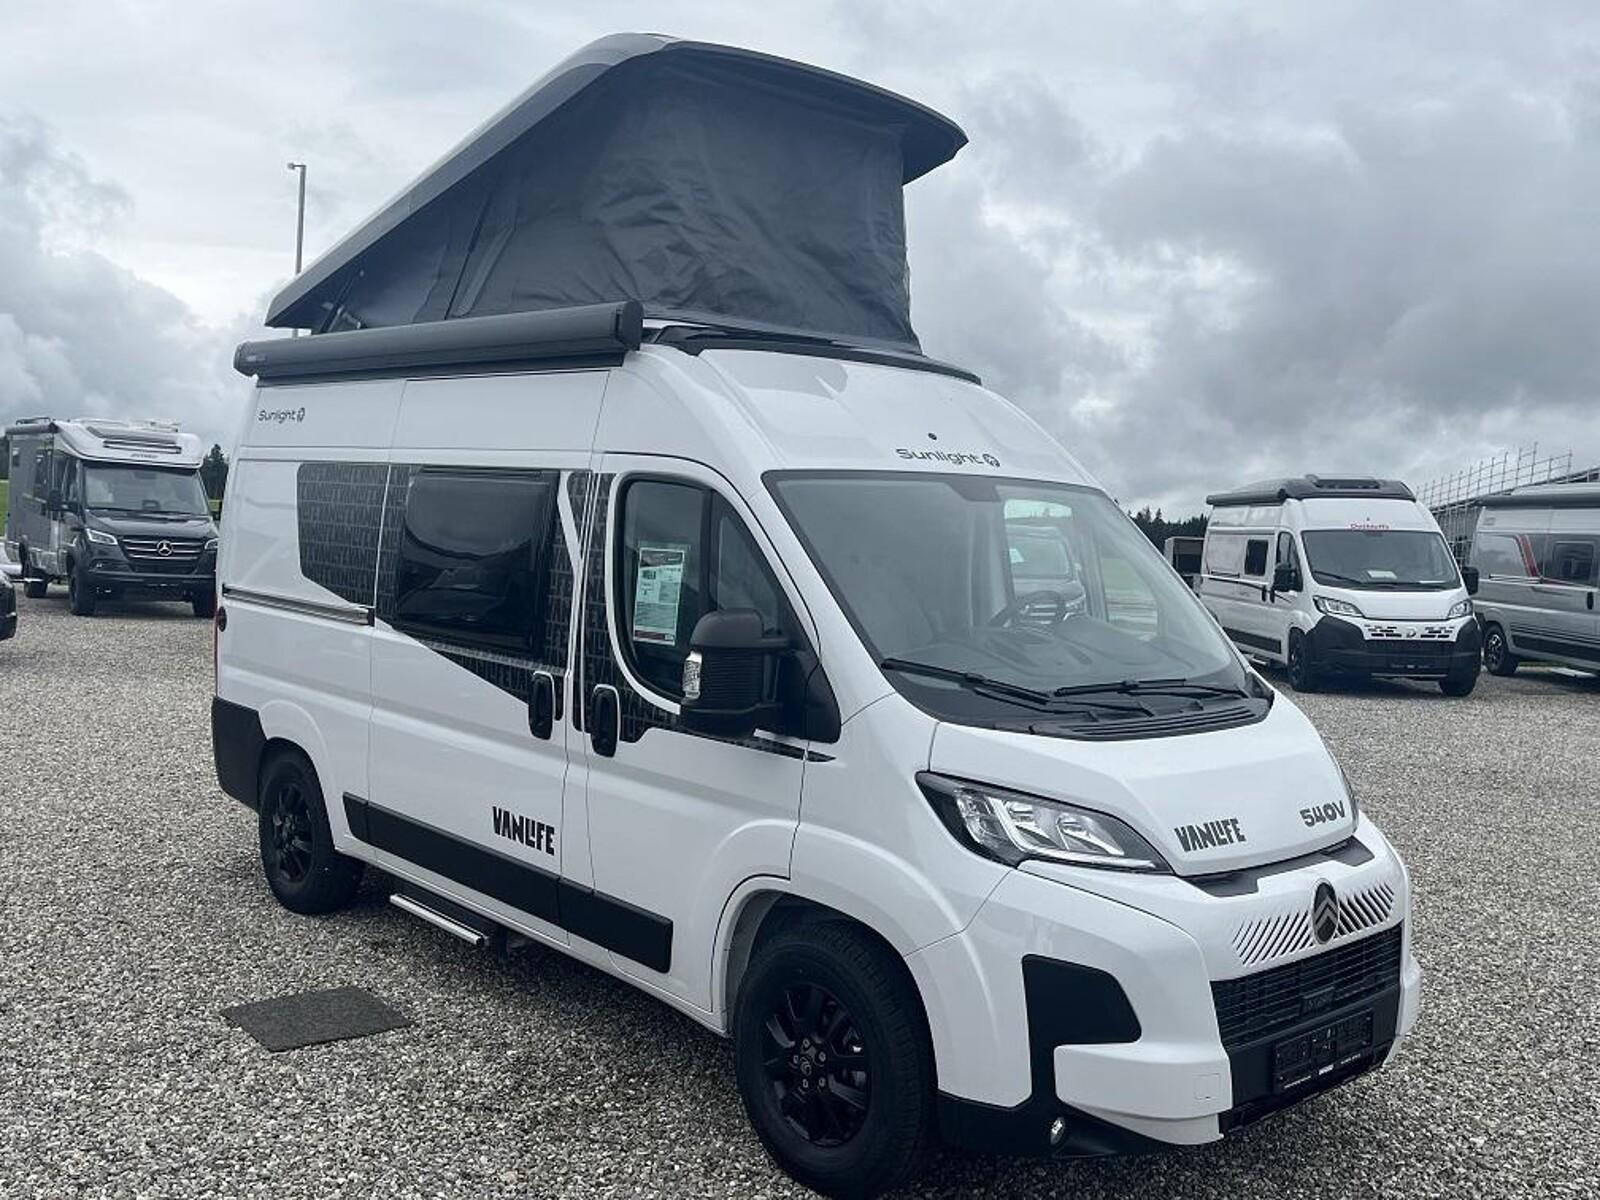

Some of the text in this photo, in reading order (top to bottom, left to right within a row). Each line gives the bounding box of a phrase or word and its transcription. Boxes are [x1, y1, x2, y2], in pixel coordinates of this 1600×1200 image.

[258, 409, 296, 424] Sunlight
[895, 448, 984, 465] Sunlight
[1300, 800, 1345, 827] 540V
[492, 806, 554, 856] VANLIFE
[1174, 818, 1246, 853] VANLIFE
